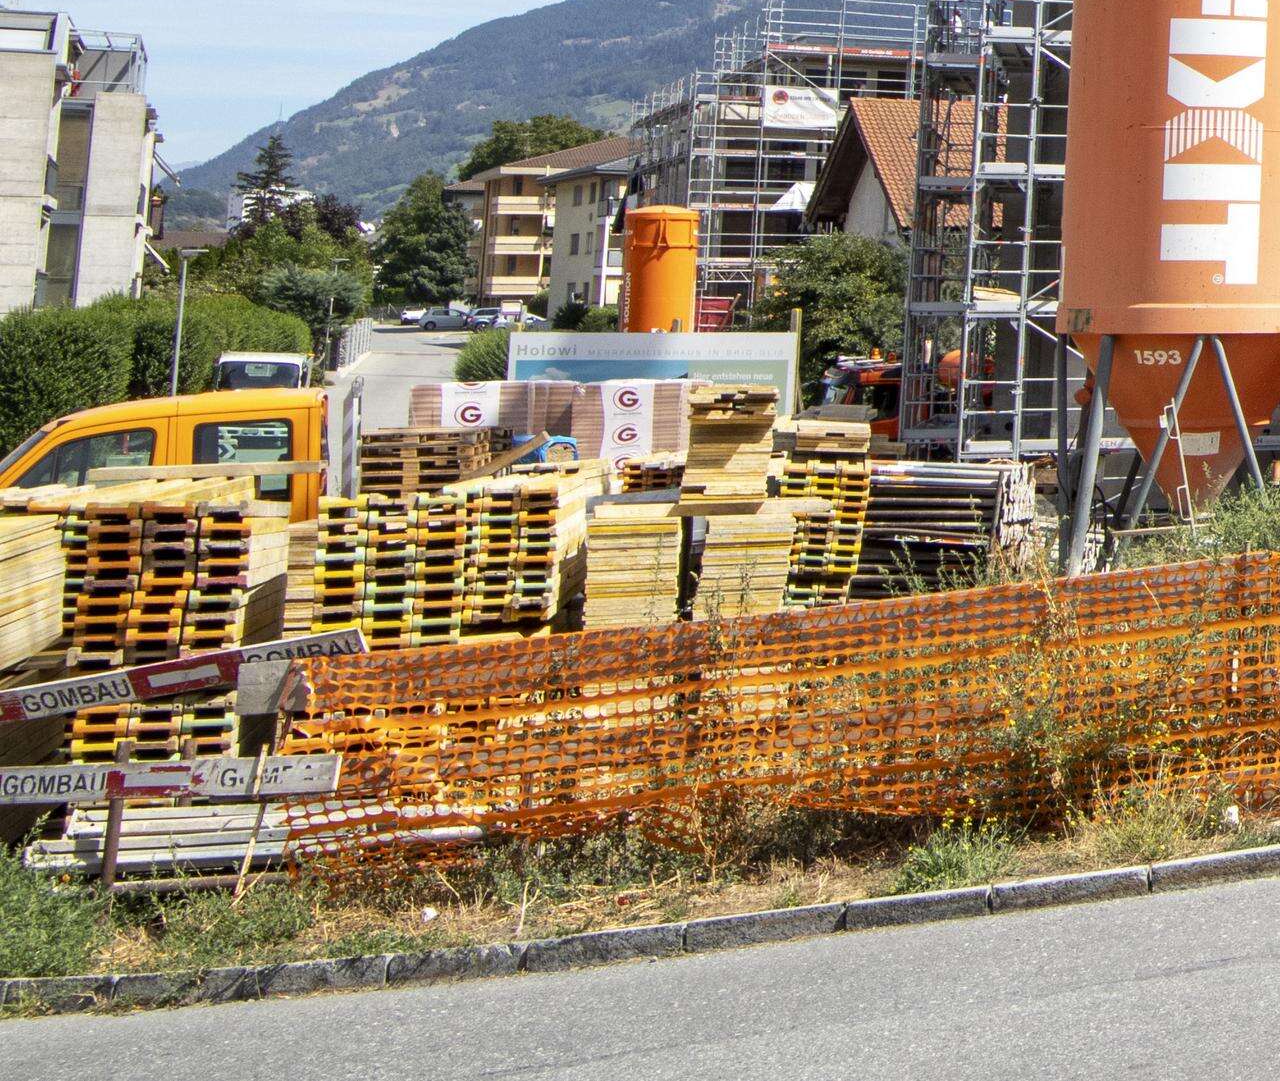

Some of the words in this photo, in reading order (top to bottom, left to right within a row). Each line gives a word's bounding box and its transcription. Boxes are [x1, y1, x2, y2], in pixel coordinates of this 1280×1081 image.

[623, 272, 631, 324] SOLUTION
[516, 344, 577, 356] Holowi
[1134, 349, 1182, 366] 1593
[711, 372, 751, 380] entstehen
[21, 678, 131, 715] GOMBAU
